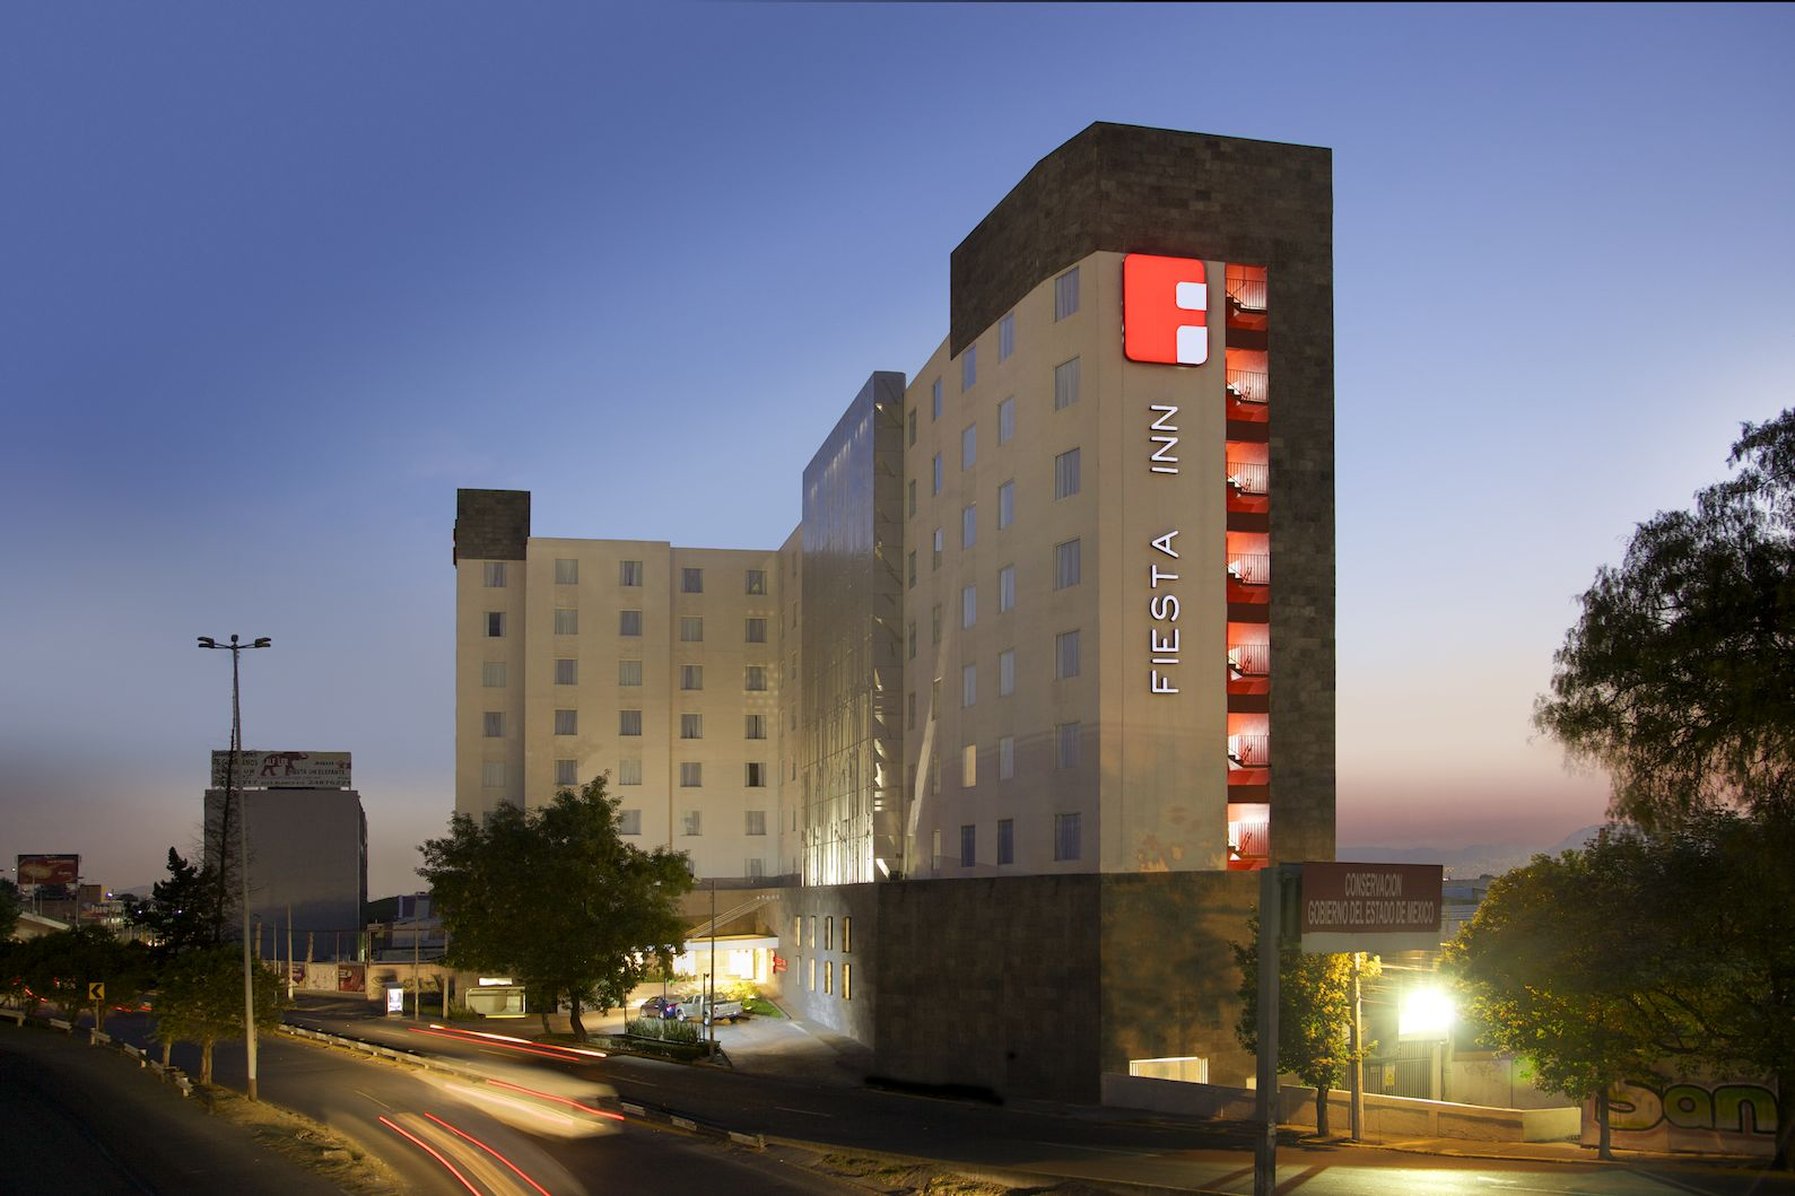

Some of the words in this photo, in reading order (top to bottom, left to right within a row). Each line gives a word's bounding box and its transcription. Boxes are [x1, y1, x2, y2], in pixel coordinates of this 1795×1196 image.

[1151, 404, 1179, 474] INN
[1151, 530, 1180, 694] FIESTA
[1345, 873, 1402, 897] CONSERVACION
[1308, 901, 1349, 925] GOBIERNO
[1350, 901, 1364, 925] DEL
[1366, 901, 1395, 925] ESTADO
[1396, 901, 1406, 925] DE
[1407, 901, 1435, 925] MEXICO
